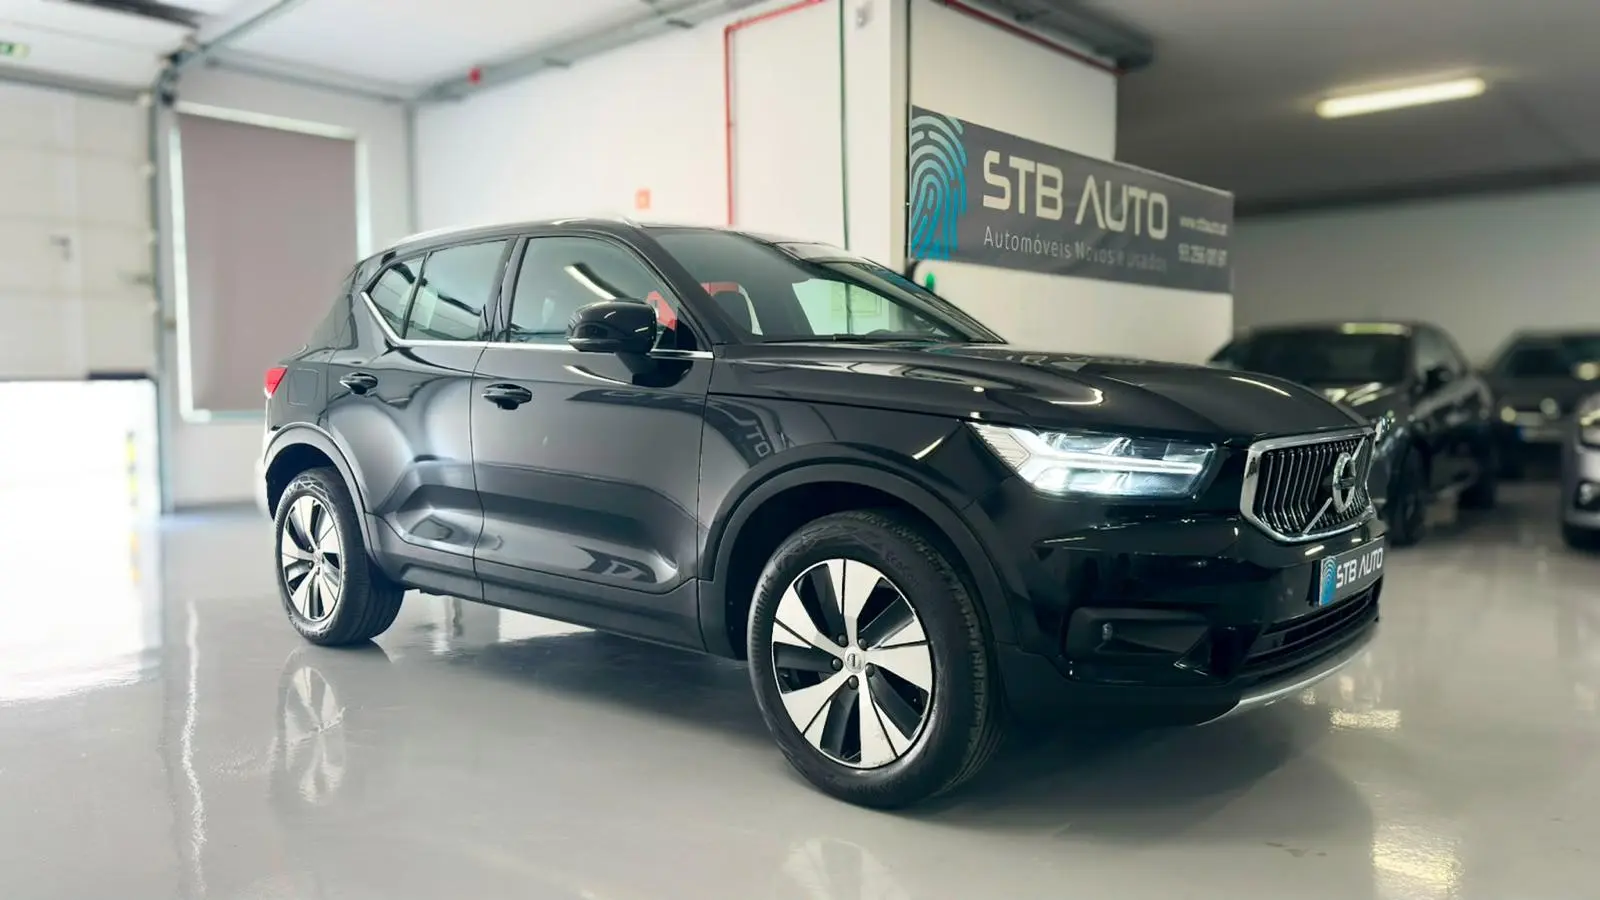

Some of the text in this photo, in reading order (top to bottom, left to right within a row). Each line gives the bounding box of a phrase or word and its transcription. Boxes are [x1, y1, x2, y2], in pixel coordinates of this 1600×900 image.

[983, 150, 1168, 240] STB AUTO
[984, 225, 1072, 260] Automóveis
[1074, 240, 1115, 266] Novos
[1336, 547, 1384, 589] STB AUTO
